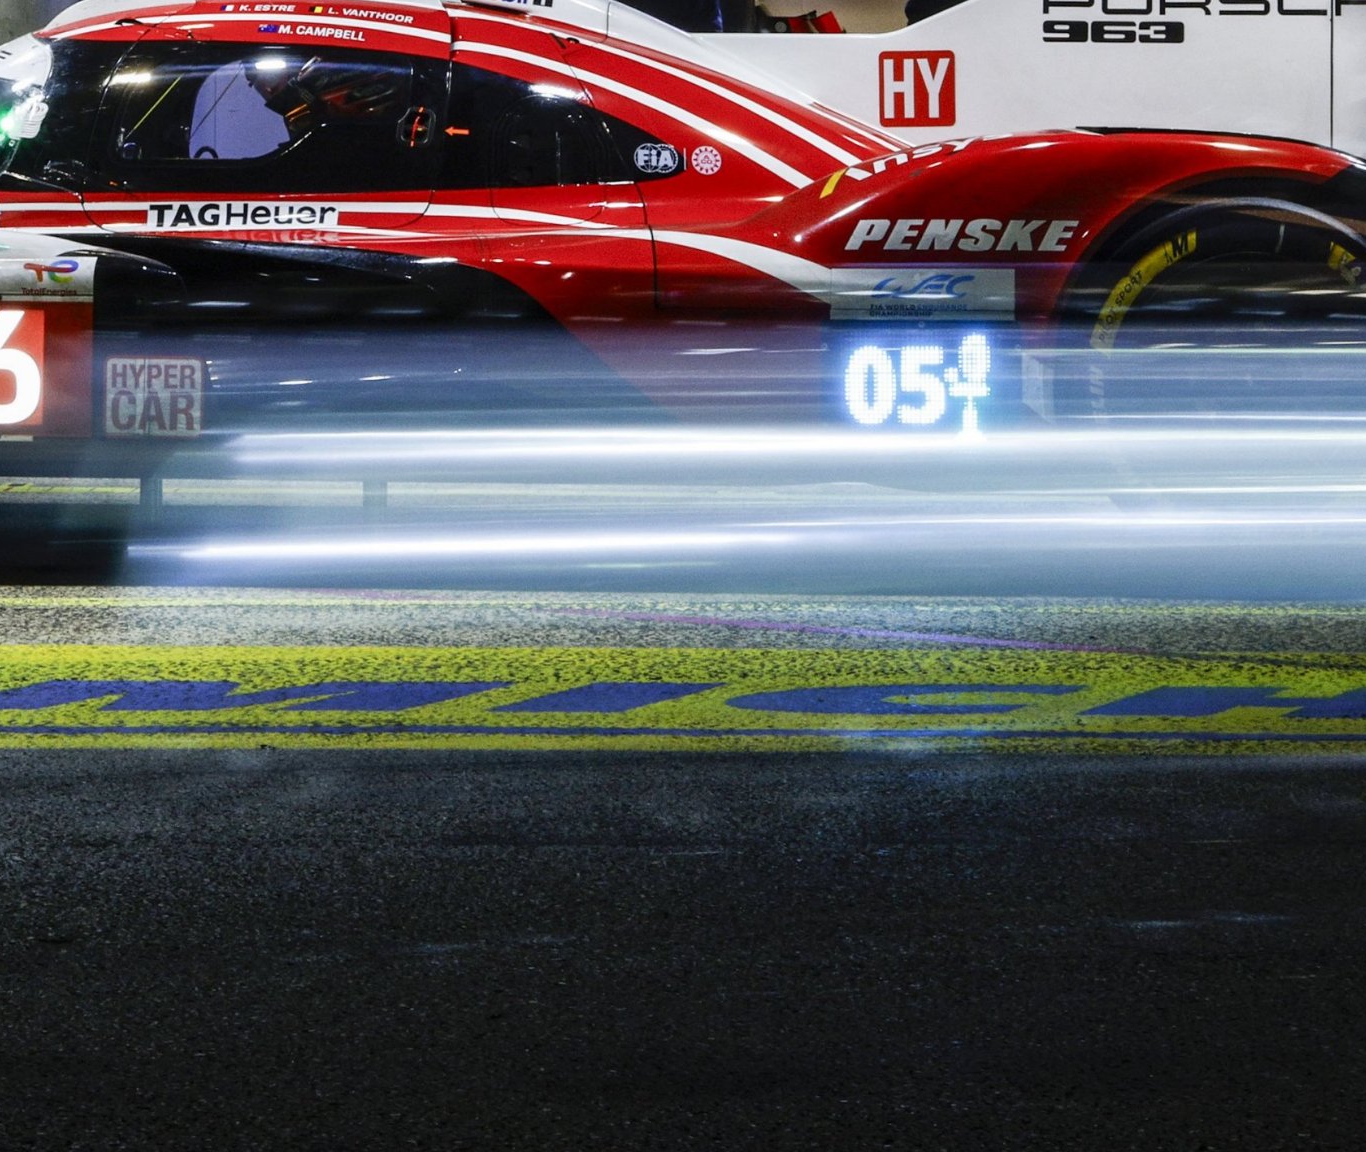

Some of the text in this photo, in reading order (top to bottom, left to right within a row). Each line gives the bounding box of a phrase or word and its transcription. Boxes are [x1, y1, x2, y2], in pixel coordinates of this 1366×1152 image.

[342, 8, 414, 24] VANTHOOR
[278, 25, 366, 41] M. CAMPBELL
[1043, 21, 1185, 42] 963
[883, 57, 949, 121] HY
[844, 219, 1080, 252] PENSKE
[21, 287, 77, 296] TotalEnergies
[110, 359, 197, 390] HYPER
[110, 391, 203, 431] CAR
